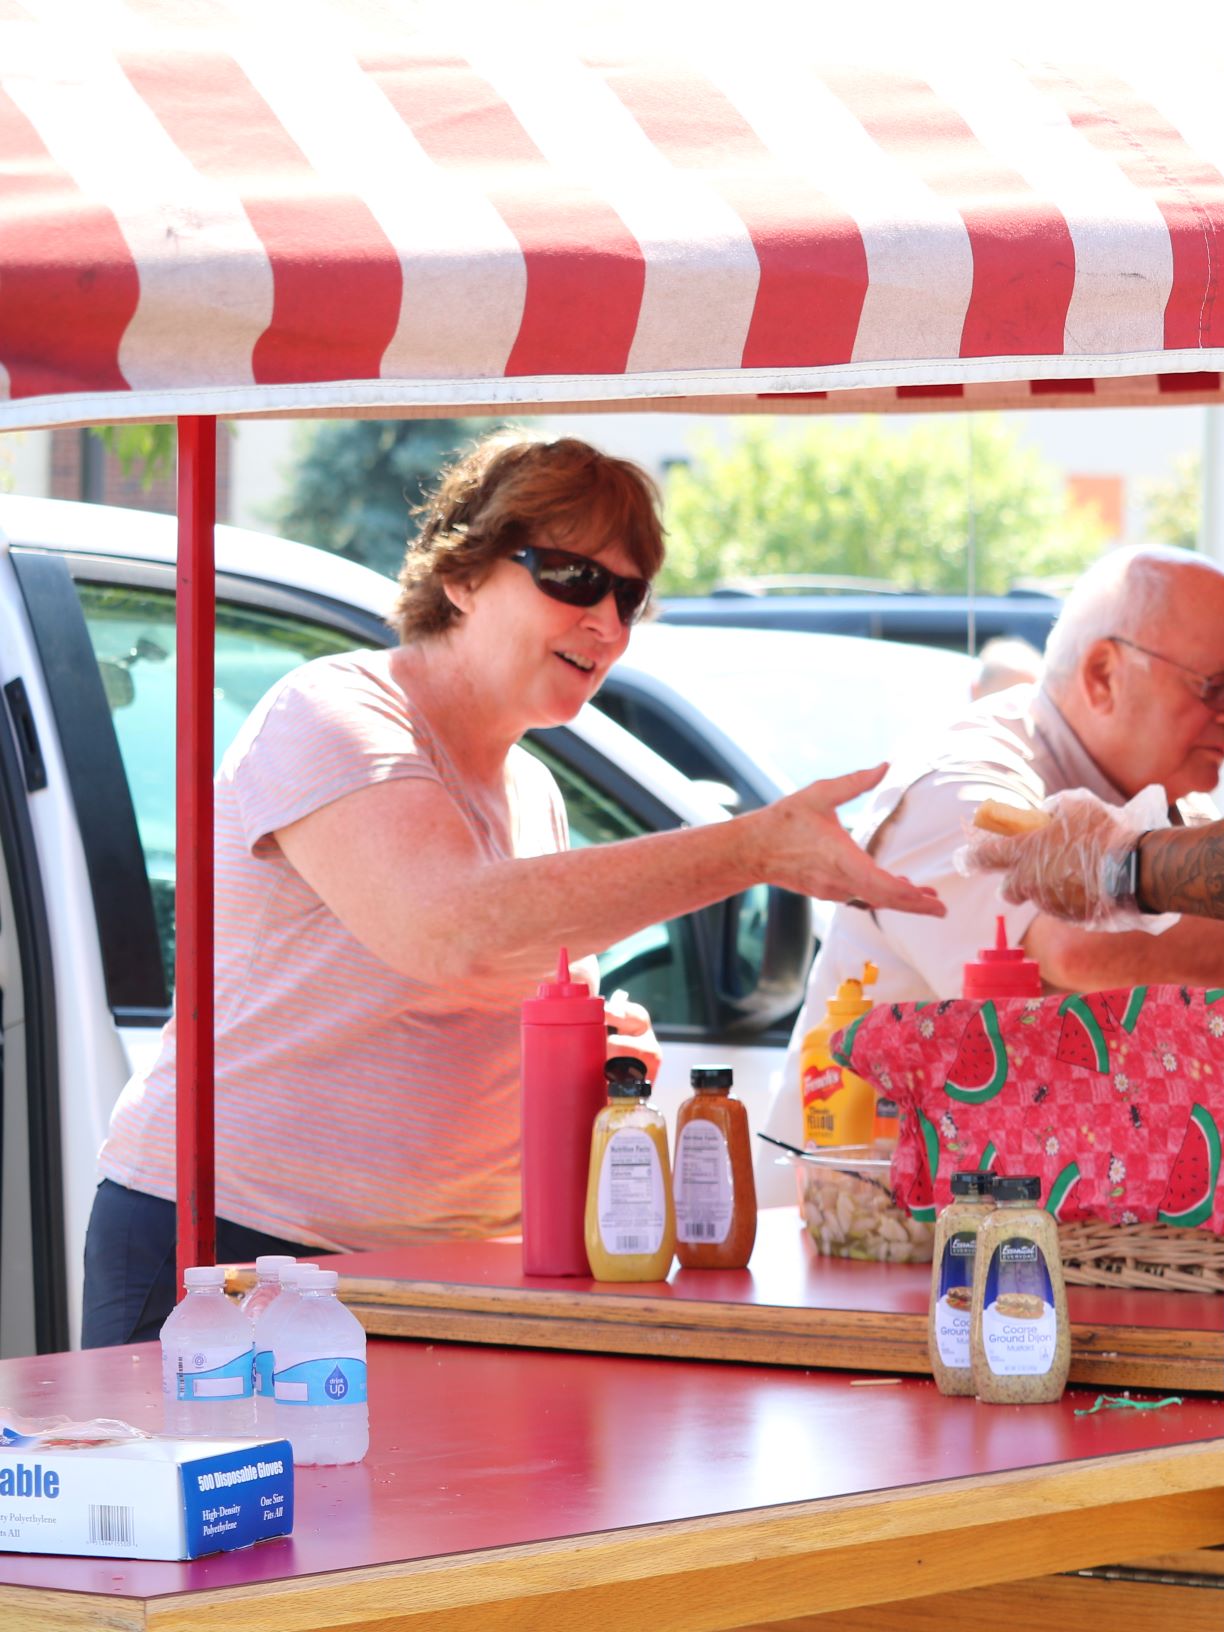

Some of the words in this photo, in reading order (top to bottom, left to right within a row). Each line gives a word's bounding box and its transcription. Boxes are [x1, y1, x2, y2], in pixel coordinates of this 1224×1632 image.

[1002, 1325, 1038, 1334] Coarse
[988, 1334, 1025, 1343] Ground
[1027, 1334, 1052, 1344] Dijon
[330, 1383, 345, 1397] up
[197, 1473, 216, 1492] 500
[213, 1464, 258, 1487] Disposable
[256, 1460, 284, 1479] Gloves
[260, 1496, 273, 1507] One
[272, 1493, 284, 1504] Size
[9, 1512, 57, 1525] Polyethylene
[202, 1504, 241, 1522] High-Density
[263, 1509, 274, 1521] Fits
[274, 1507, 284, 1518] All
[8, 1529, 21, 1537] All
[203, 1520, 238, 1537] Polyethylene
